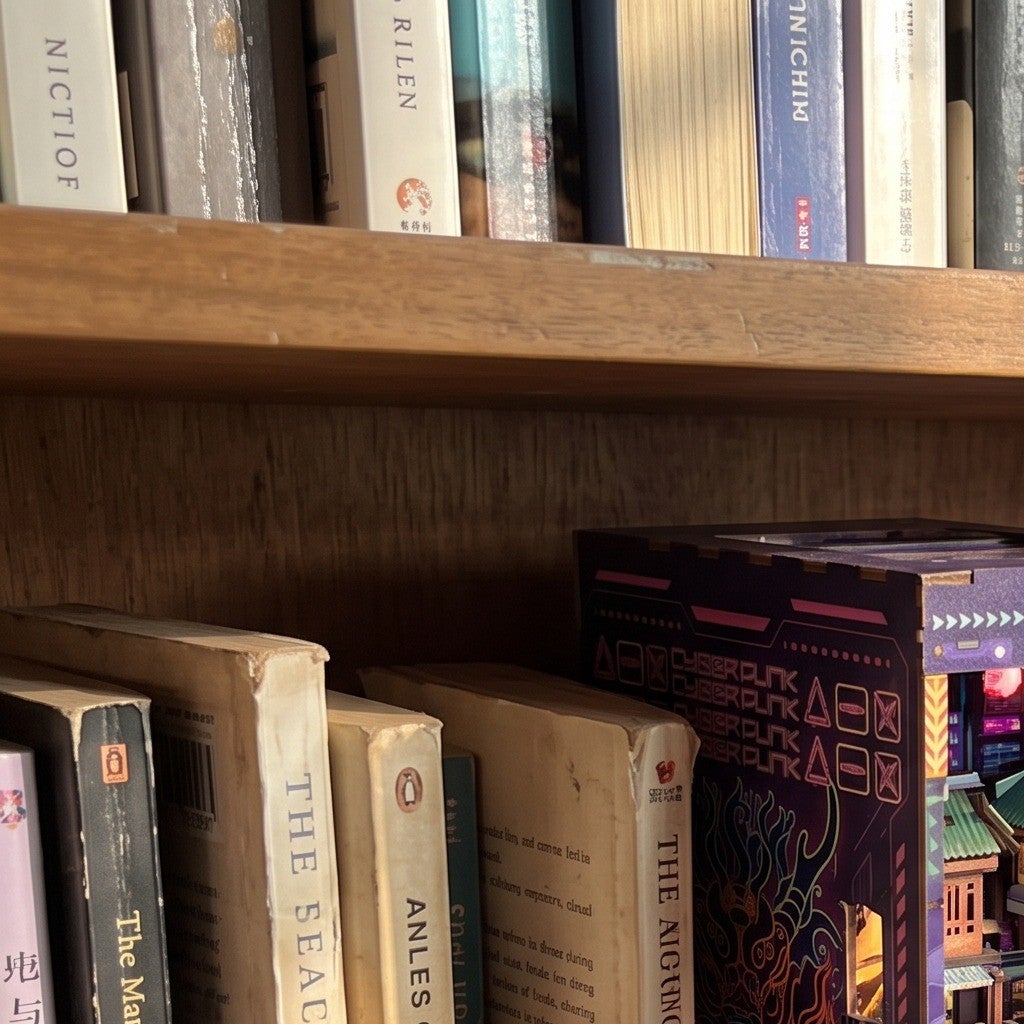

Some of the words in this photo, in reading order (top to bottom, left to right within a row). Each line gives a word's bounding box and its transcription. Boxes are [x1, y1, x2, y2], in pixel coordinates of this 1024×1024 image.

[44, 37, 80, 191] NICTIOF
[286, 771, 318, 876] THE
[656, 833, 680, 905] THE
[115, 909, 142, 969] The
[406, 897, 432, 1009] ANLES
